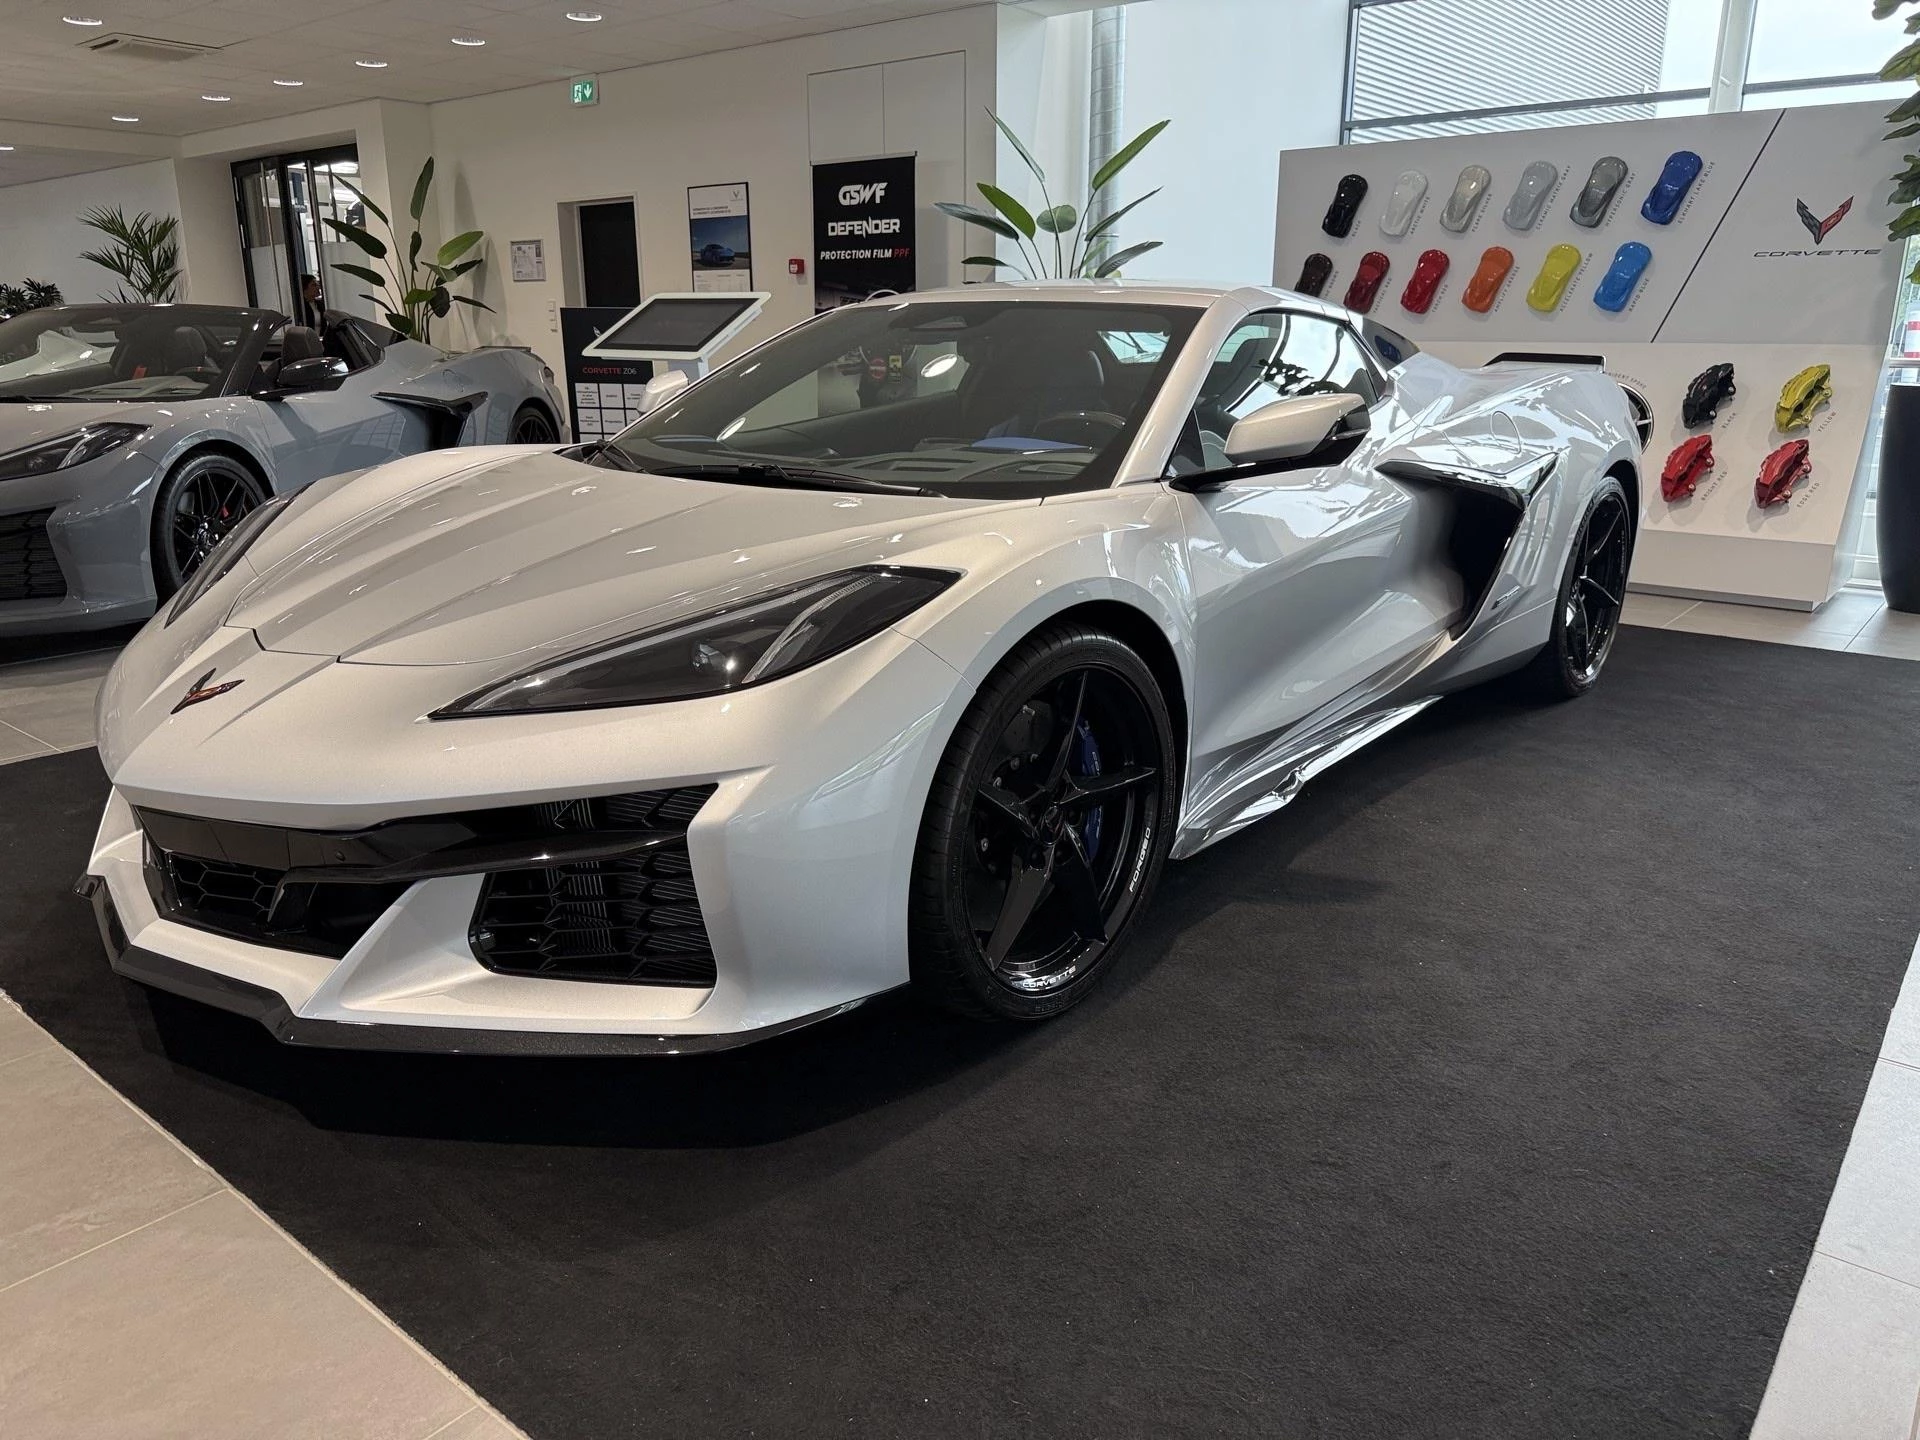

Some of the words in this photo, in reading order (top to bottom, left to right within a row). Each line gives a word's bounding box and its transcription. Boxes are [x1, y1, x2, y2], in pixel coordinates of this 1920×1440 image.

[1693, 179, 1706, 196] LAKE
[1703, 161, 1715, 178] BLUE
[838, 182, 888, 205] GSWF
[828, 216, 900, 239] DEFENDER
[820, 250, 872, 260] PROTECTION
[873, 249, 892, 259] FILM
[894, 248, 910, 257] PPF
[1753, 248, 1882, 257] CORVETTE
[1628, 294, 1641, 313] RAPID
[1638, 278, 1650, 294] BLUE
[1721, 412, 1737, 430] BLACK
[1817, 411, 1837, 433] YELLOW
[1700, 482, 1719, 502] BRIGHT
[1716, 470, 1729, 483] RED
[1796, 494, 1810, 509] EDGE
[1809, 482, 1821, 494] RED
[1129, 827, 1150, 893] FORGED
[1022, 965, 1076, 988] CORVETTE
